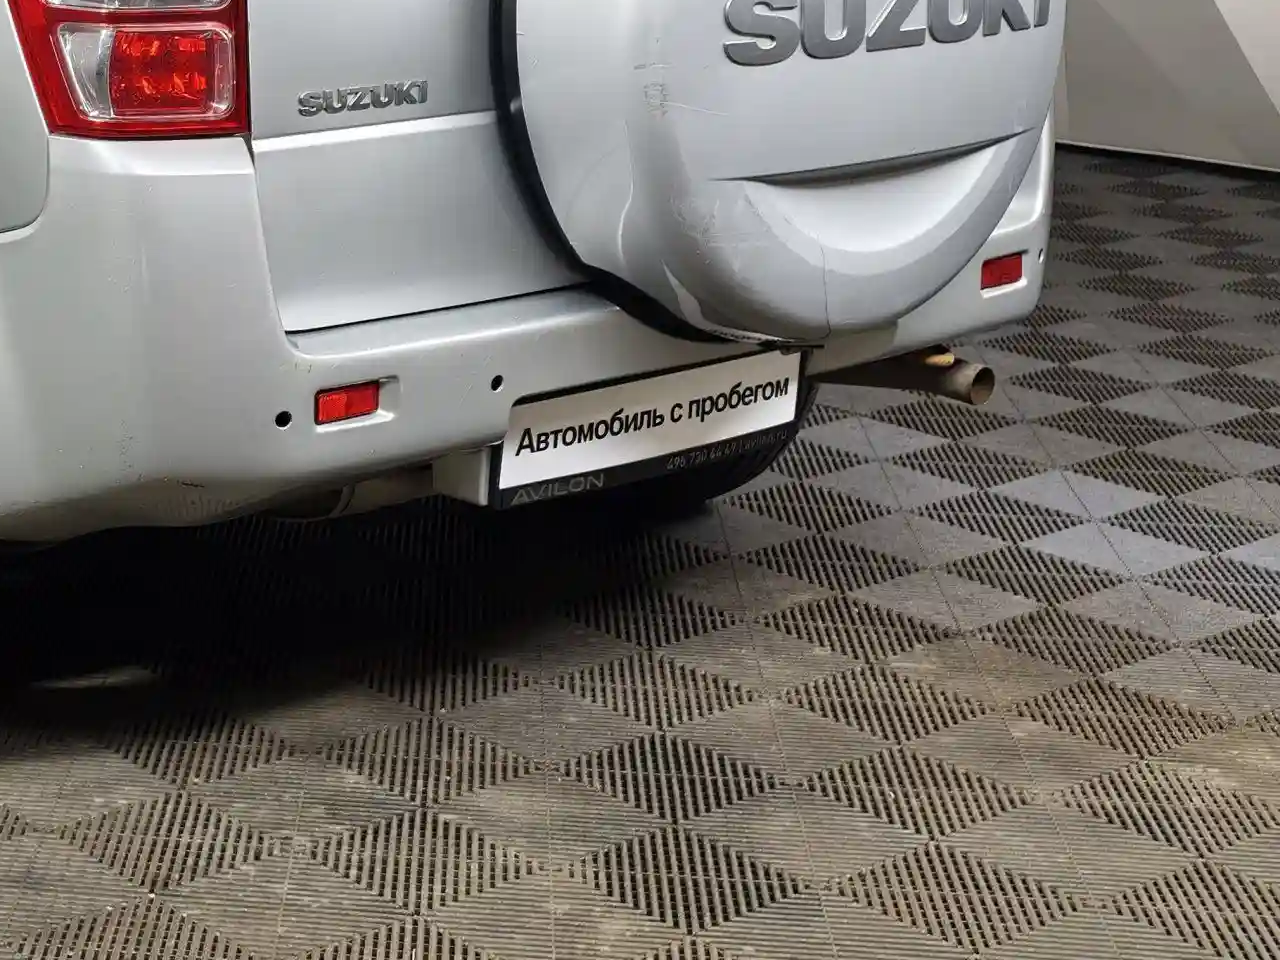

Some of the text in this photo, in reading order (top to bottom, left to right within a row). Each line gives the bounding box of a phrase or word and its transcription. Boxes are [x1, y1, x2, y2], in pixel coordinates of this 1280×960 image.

[297, 79, 428, 118] SUZUKI
[514, 376, 790, 457] Автомобиль с пробегом
[510, 472, 605, 506] AVILON
